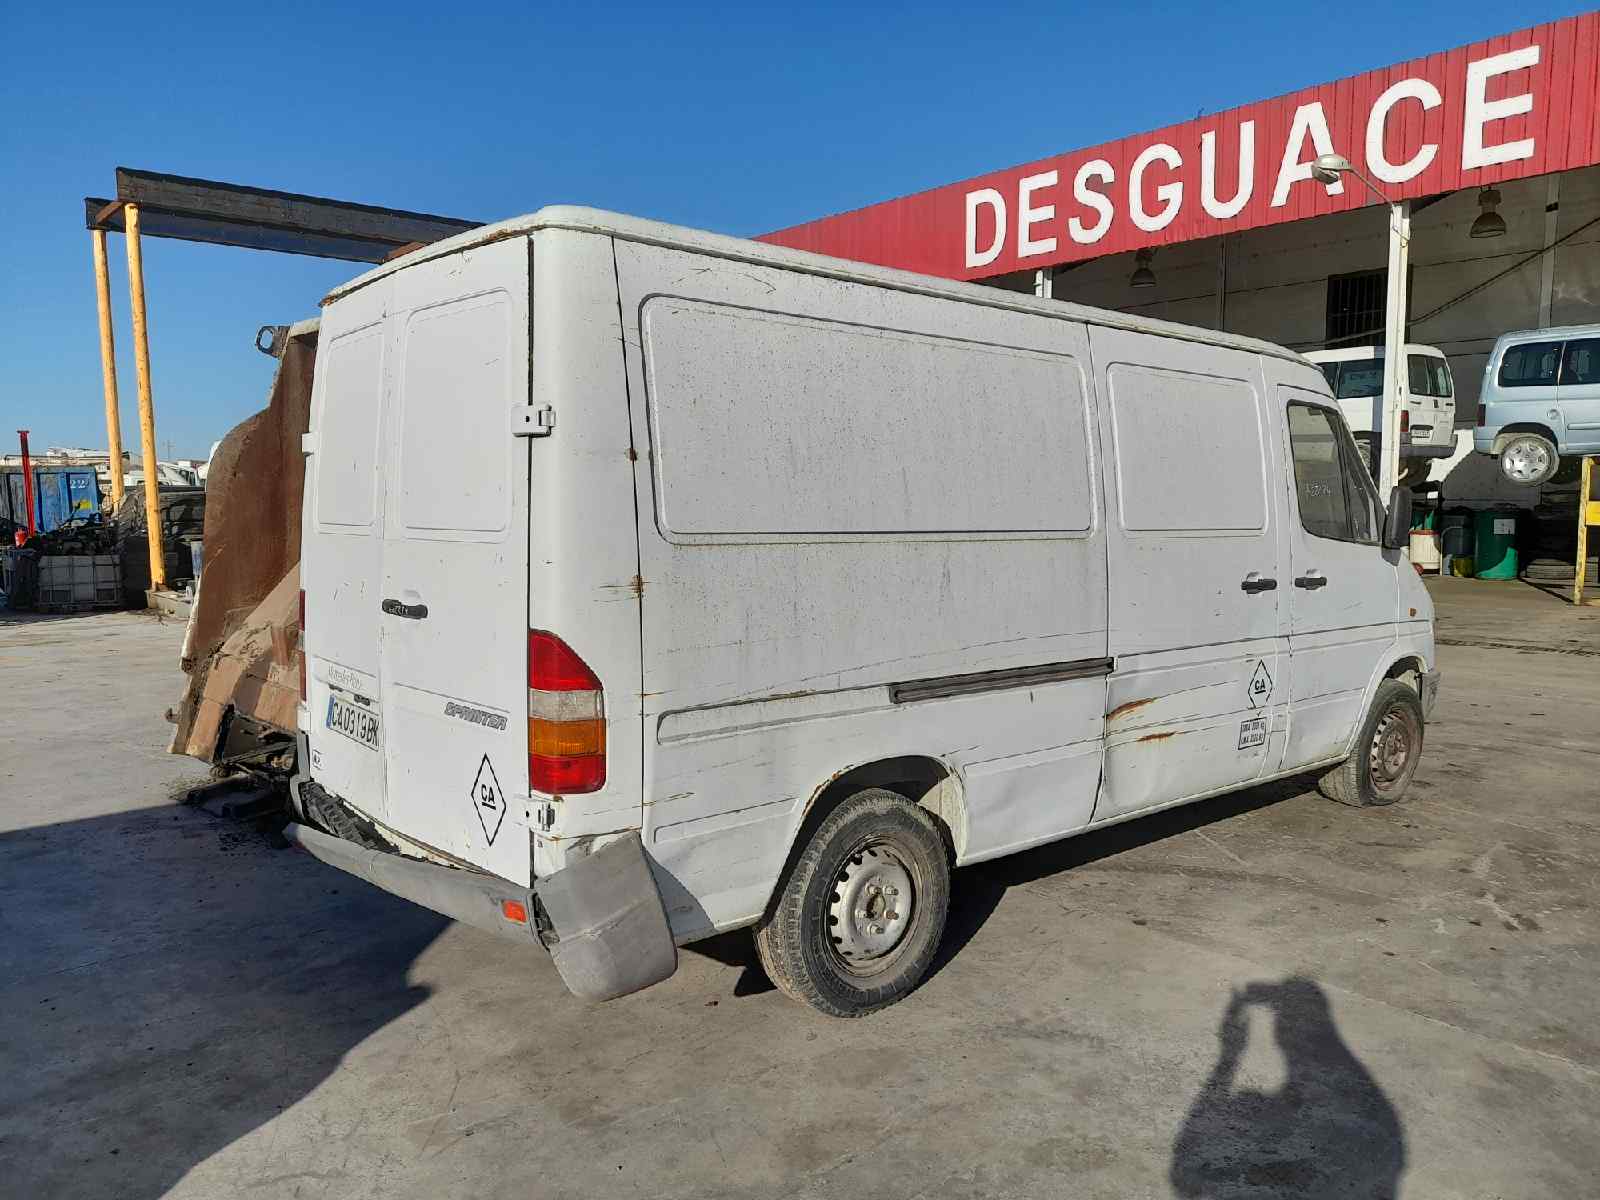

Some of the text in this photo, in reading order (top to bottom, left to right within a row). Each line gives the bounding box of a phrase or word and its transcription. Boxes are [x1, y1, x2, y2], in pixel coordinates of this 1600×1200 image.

[964, 44, 1541, 269] DESGUACE
[1254, 679, 1266, 691] CA
[481, 784, 496, 805] CA
